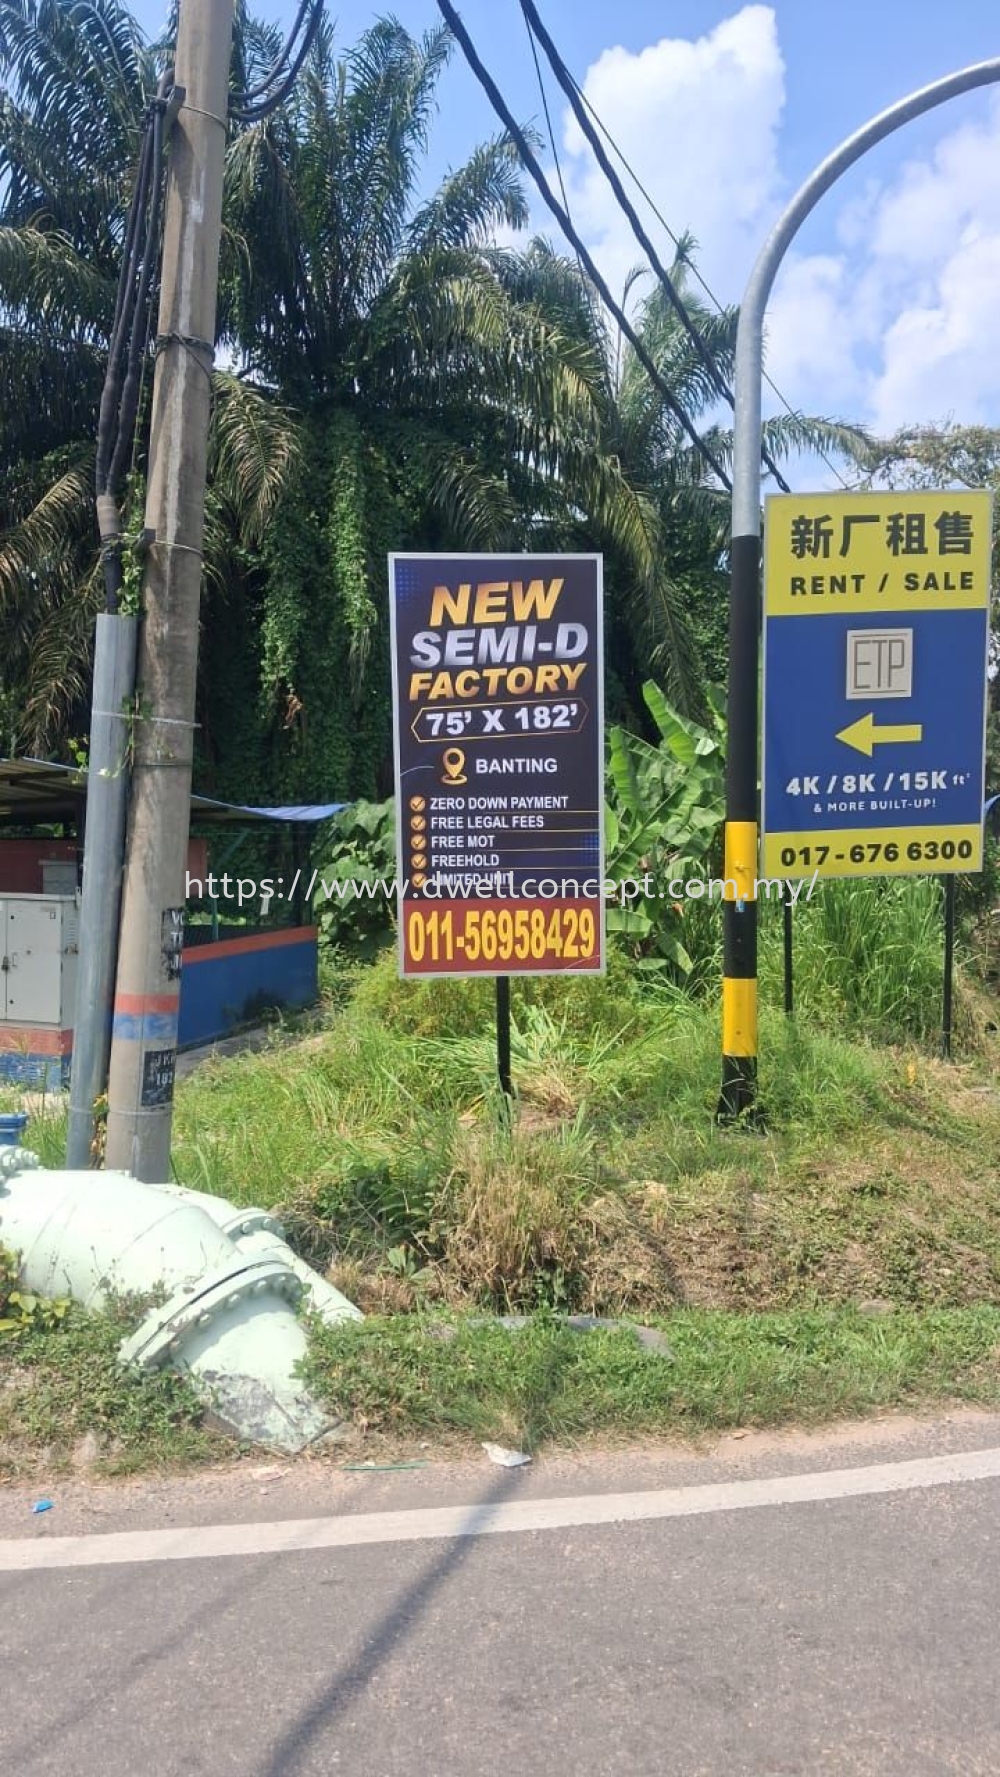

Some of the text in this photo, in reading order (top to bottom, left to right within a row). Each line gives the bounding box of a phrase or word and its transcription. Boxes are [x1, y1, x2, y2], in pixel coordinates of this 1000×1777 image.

[790, 511, 974, 559] 新厂租售
[790, 572, 974, 596] RENT / SALE
[429, 578, 565, 627] NEW
[410, 622, 588, 668] SEMI-D
[853, 639, 905, 689] ETP
[409, 663, 587, 700] FACTORY
[482, 708, 505, 732] X
[475, 757, 558, 774] BANTING
[785, 776, 820, 796] 4K
[826, 775, 838, 794] /
[842, 774, 876, 794] 8K
[883, 773, 894, 792] /
[900, 771, 948, 791] 15K
[430, 796, 569, 810] ZERO DOWN PAYMENT
[813, 798, 937, 813] & MORE BUILT-UP!
[431, 815, 545, 829] FREE LEGAL FEES
[431, 835, 495, 848] FREE MOT
[907, 840, 973, 862] 6300
[431, 854, 500, 867] FREEHOLD
[431, 873, 515, 886] LIMITED UNIT
[409, 908, 596, 962] 011-56958429
